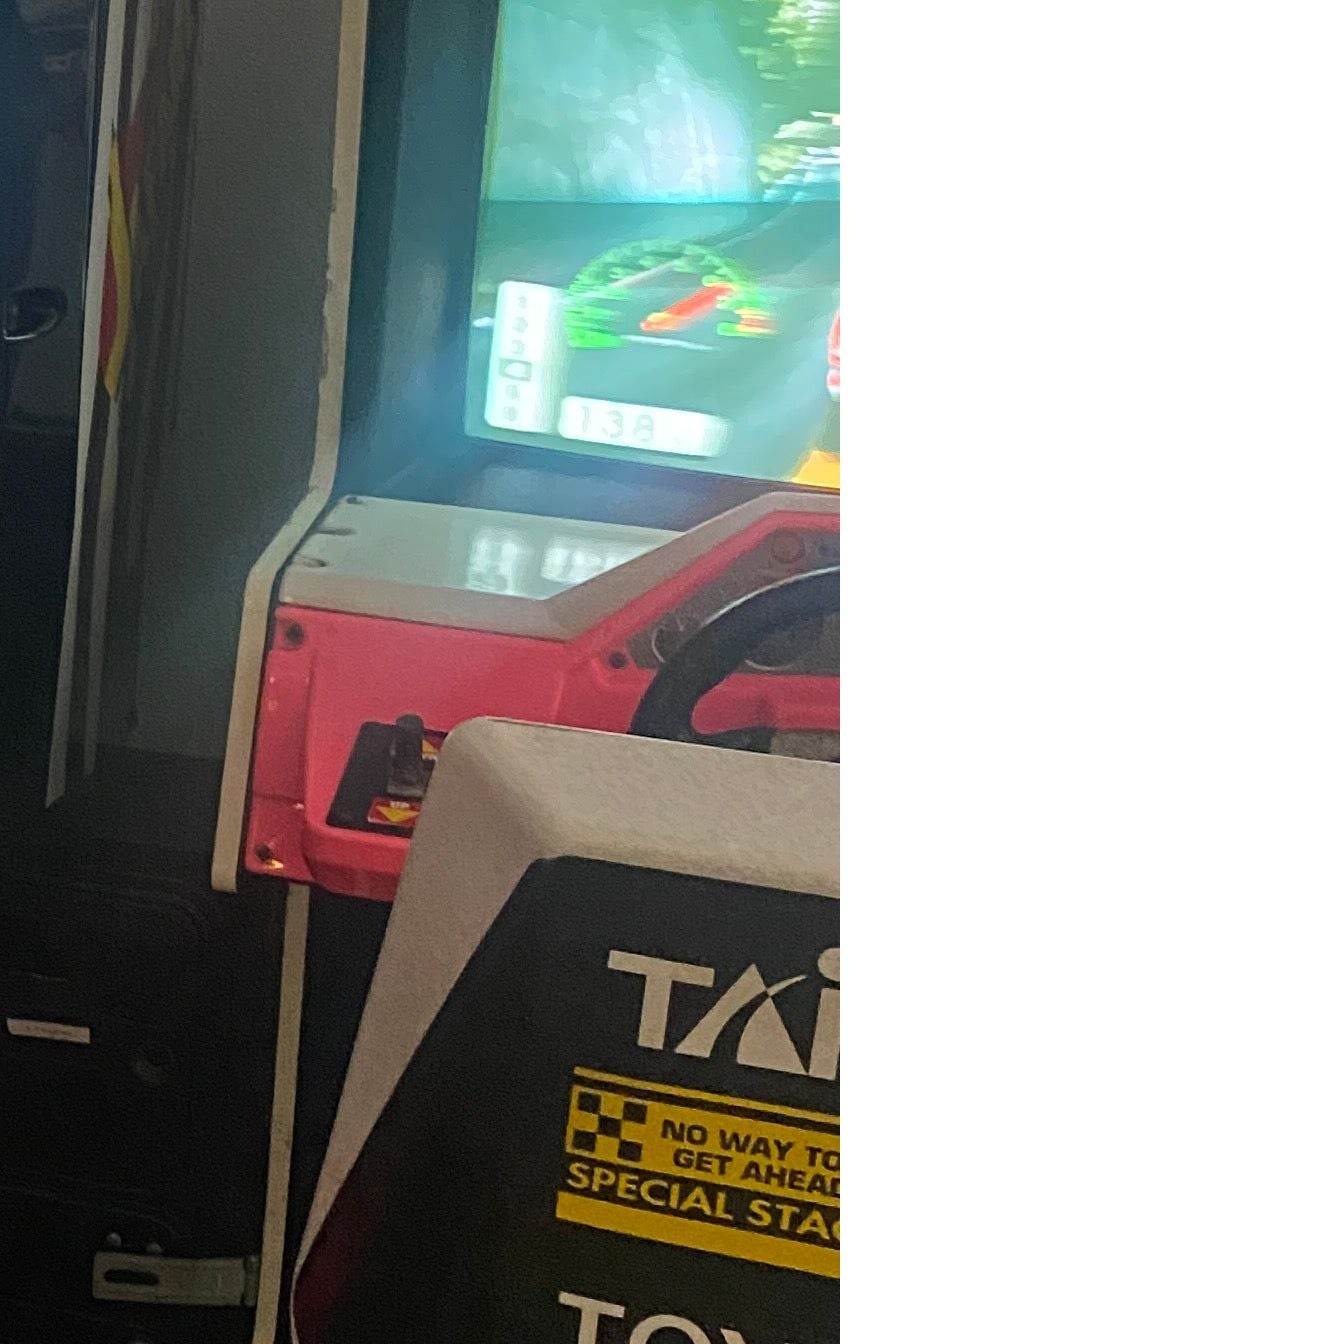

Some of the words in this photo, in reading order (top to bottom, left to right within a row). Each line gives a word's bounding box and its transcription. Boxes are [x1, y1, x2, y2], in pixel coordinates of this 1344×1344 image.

[661, 1119, 708, 1146] NO
[719, 1128, 793, 1161] WAY
[567, 1162, 734, 1221] SPECIAL
[672, 1149, 733, 1176] GET
[740, 1160, 840, 1197] AHEA
